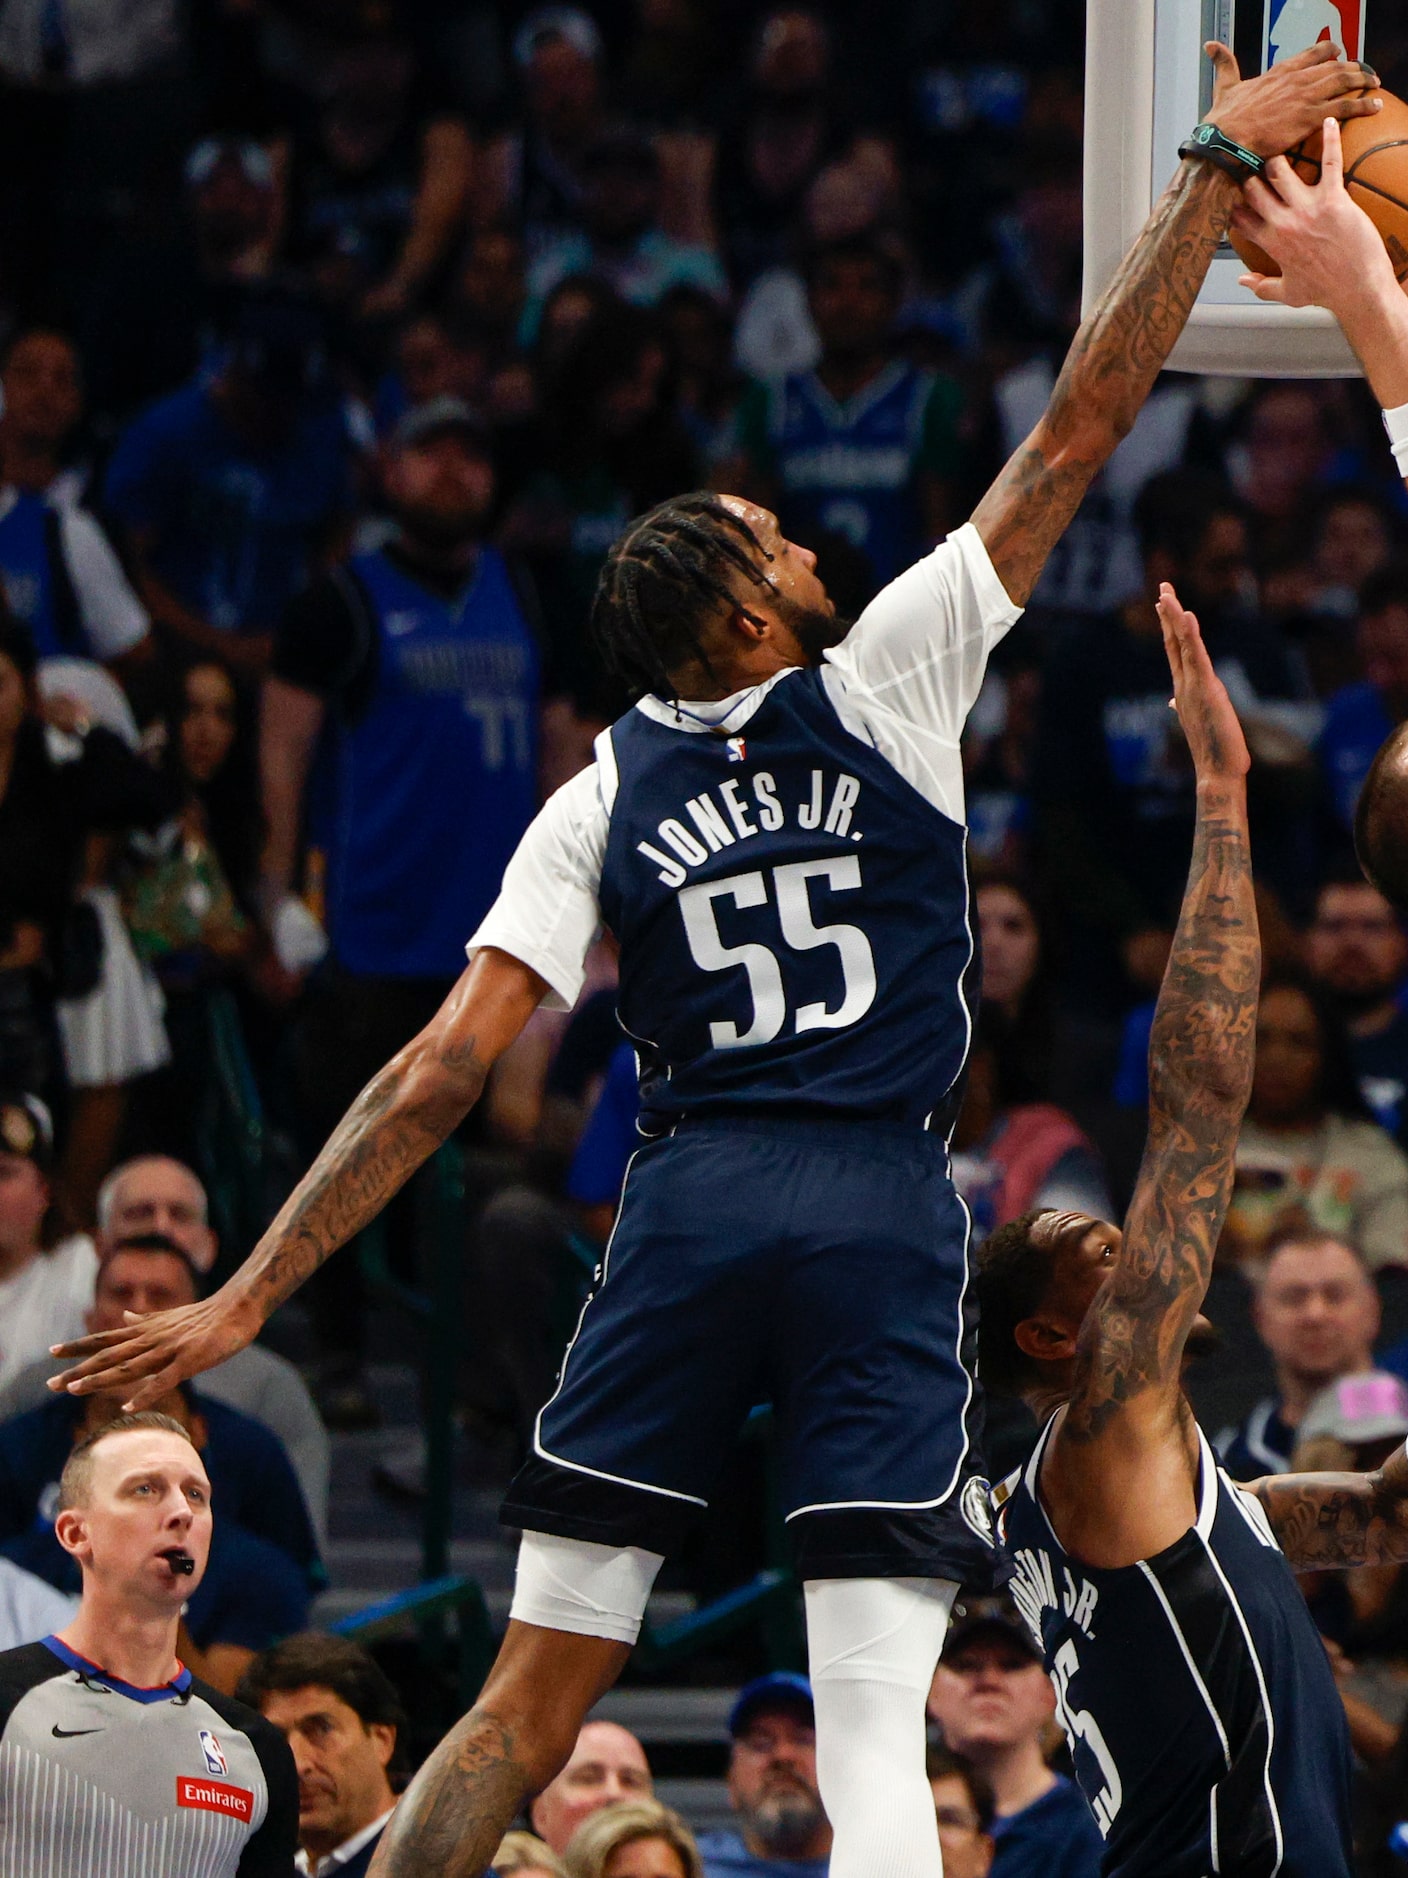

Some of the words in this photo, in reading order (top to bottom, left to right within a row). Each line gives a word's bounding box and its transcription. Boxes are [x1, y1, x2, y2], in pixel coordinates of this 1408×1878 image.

[636, 771, 785, 888] JONES
[797, 769, 864, 842] JR.
[677, 854, 878, 1051] 55
[1062, 1566, 1099, 1641] JR.
[184, 1783, 247, 1813] Emirates
